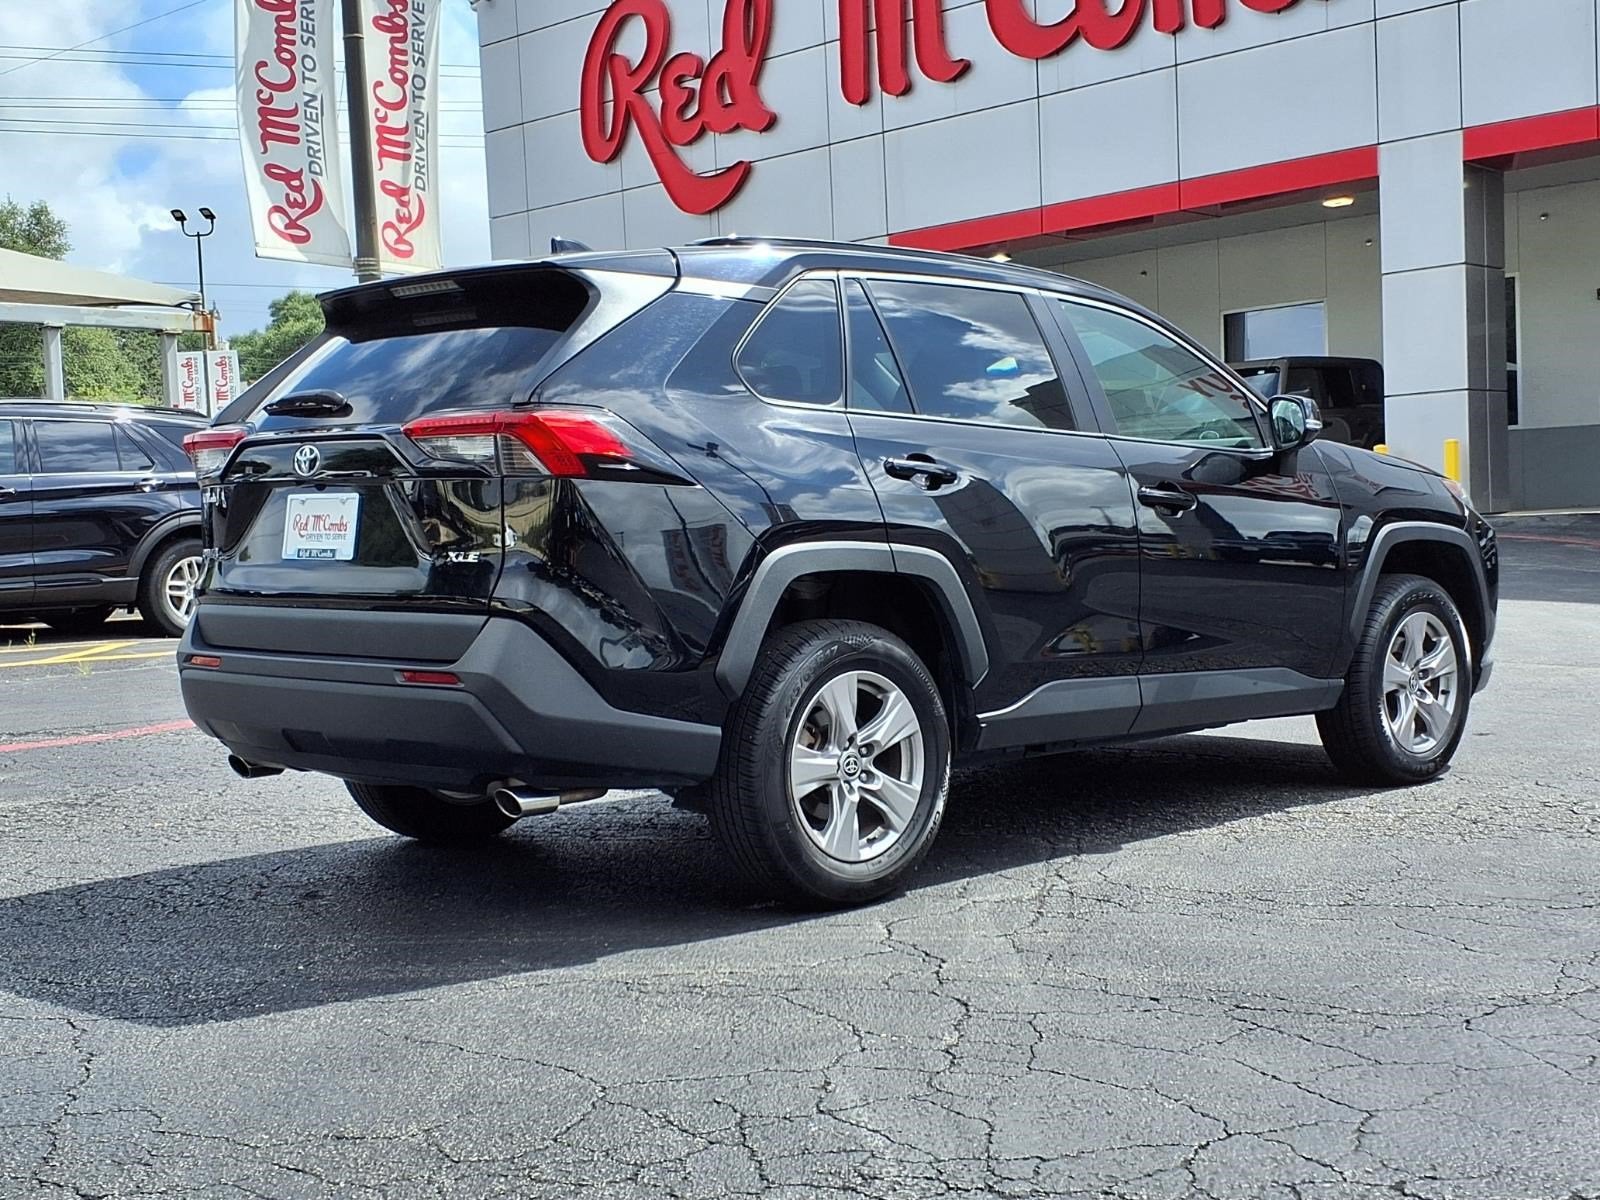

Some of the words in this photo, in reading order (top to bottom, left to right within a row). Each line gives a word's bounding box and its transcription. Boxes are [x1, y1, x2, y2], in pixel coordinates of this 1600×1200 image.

[301, 55, 317, 85] TO
[411, 0, 426, 68] SERVE
[411, 74, 427, 104] TO
[579, 0, 778, 216] Red
[304, 90, 323, 177] DRIVEN
[414, 112, 426, 192] DRIVEN
[263, 163, 323, 244] Red
[380, 179, 425, 259] Red
[293, 514, 310, 538] Red
[312, 513, 348, 532] McCombs
[446, 551, 480, 563] XLE
